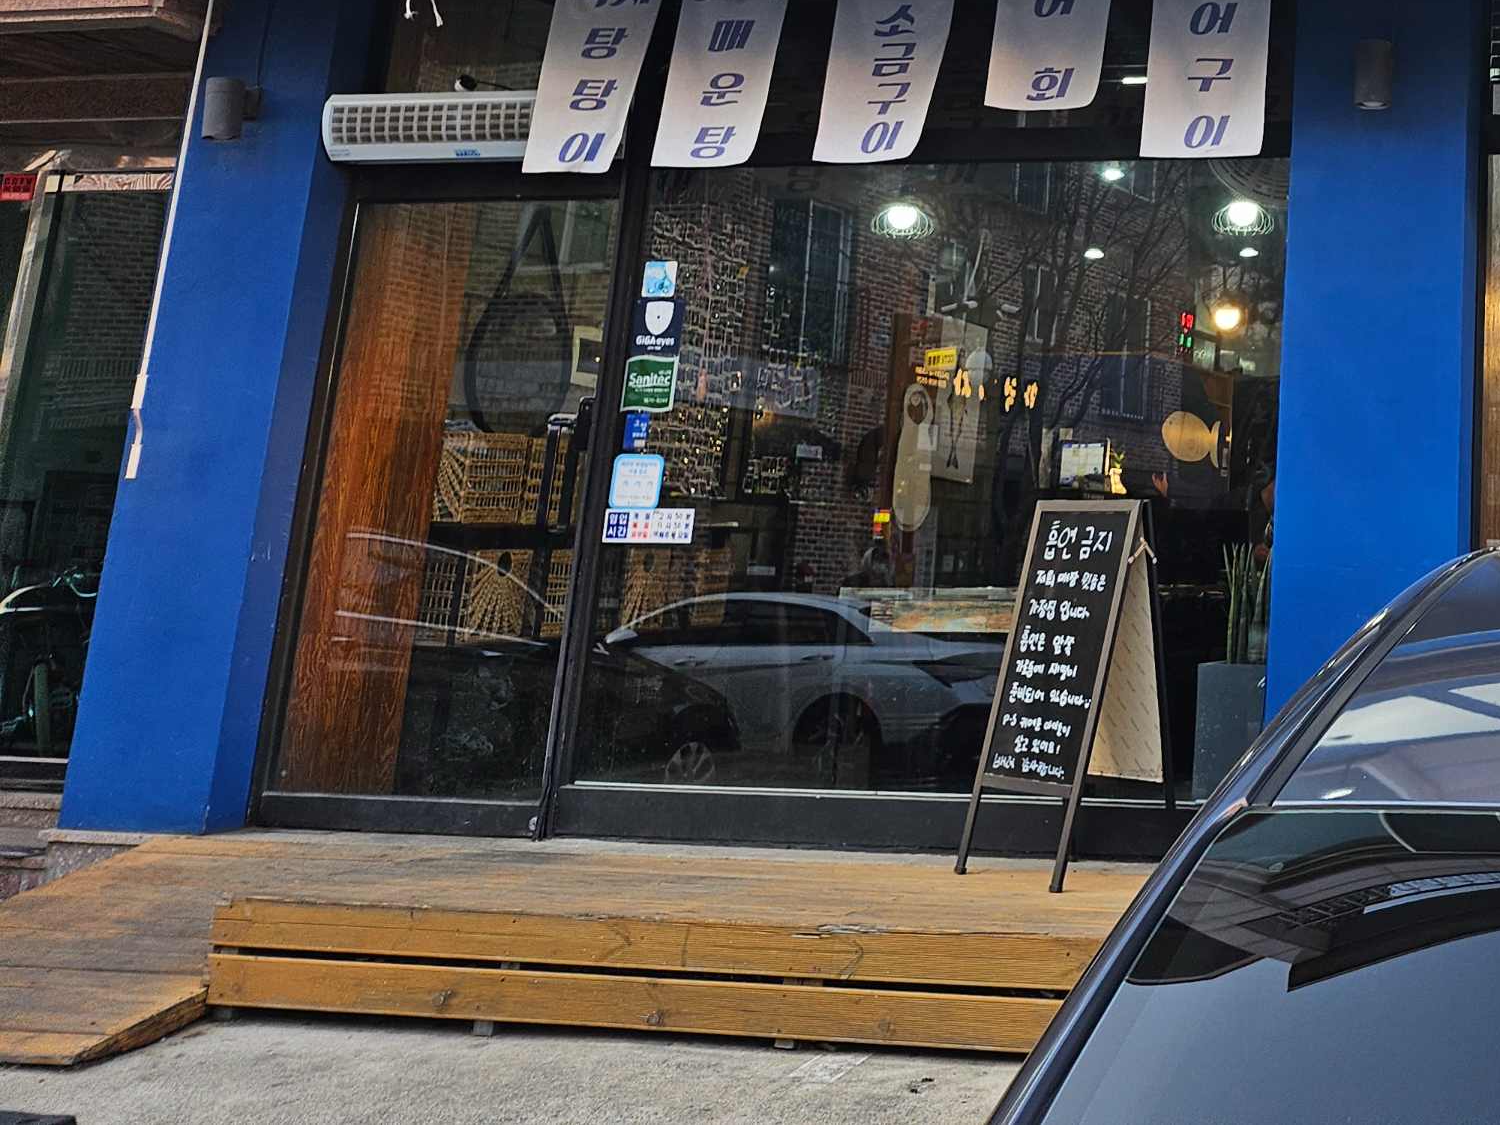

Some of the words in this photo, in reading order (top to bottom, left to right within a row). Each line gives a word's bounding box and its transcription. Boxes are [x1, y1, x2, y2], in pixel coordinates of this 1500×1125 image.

[860, 4, 918, 155] 소금구이
[1043, 520, 1079, 561] 흡연
[1079, 526, 1113, 561] 금지
[1035, 569, 1056, 589] 저희
[1056, 570, 1080, 588] 매장
[1019, 624, 1046, 653] 흡연은
